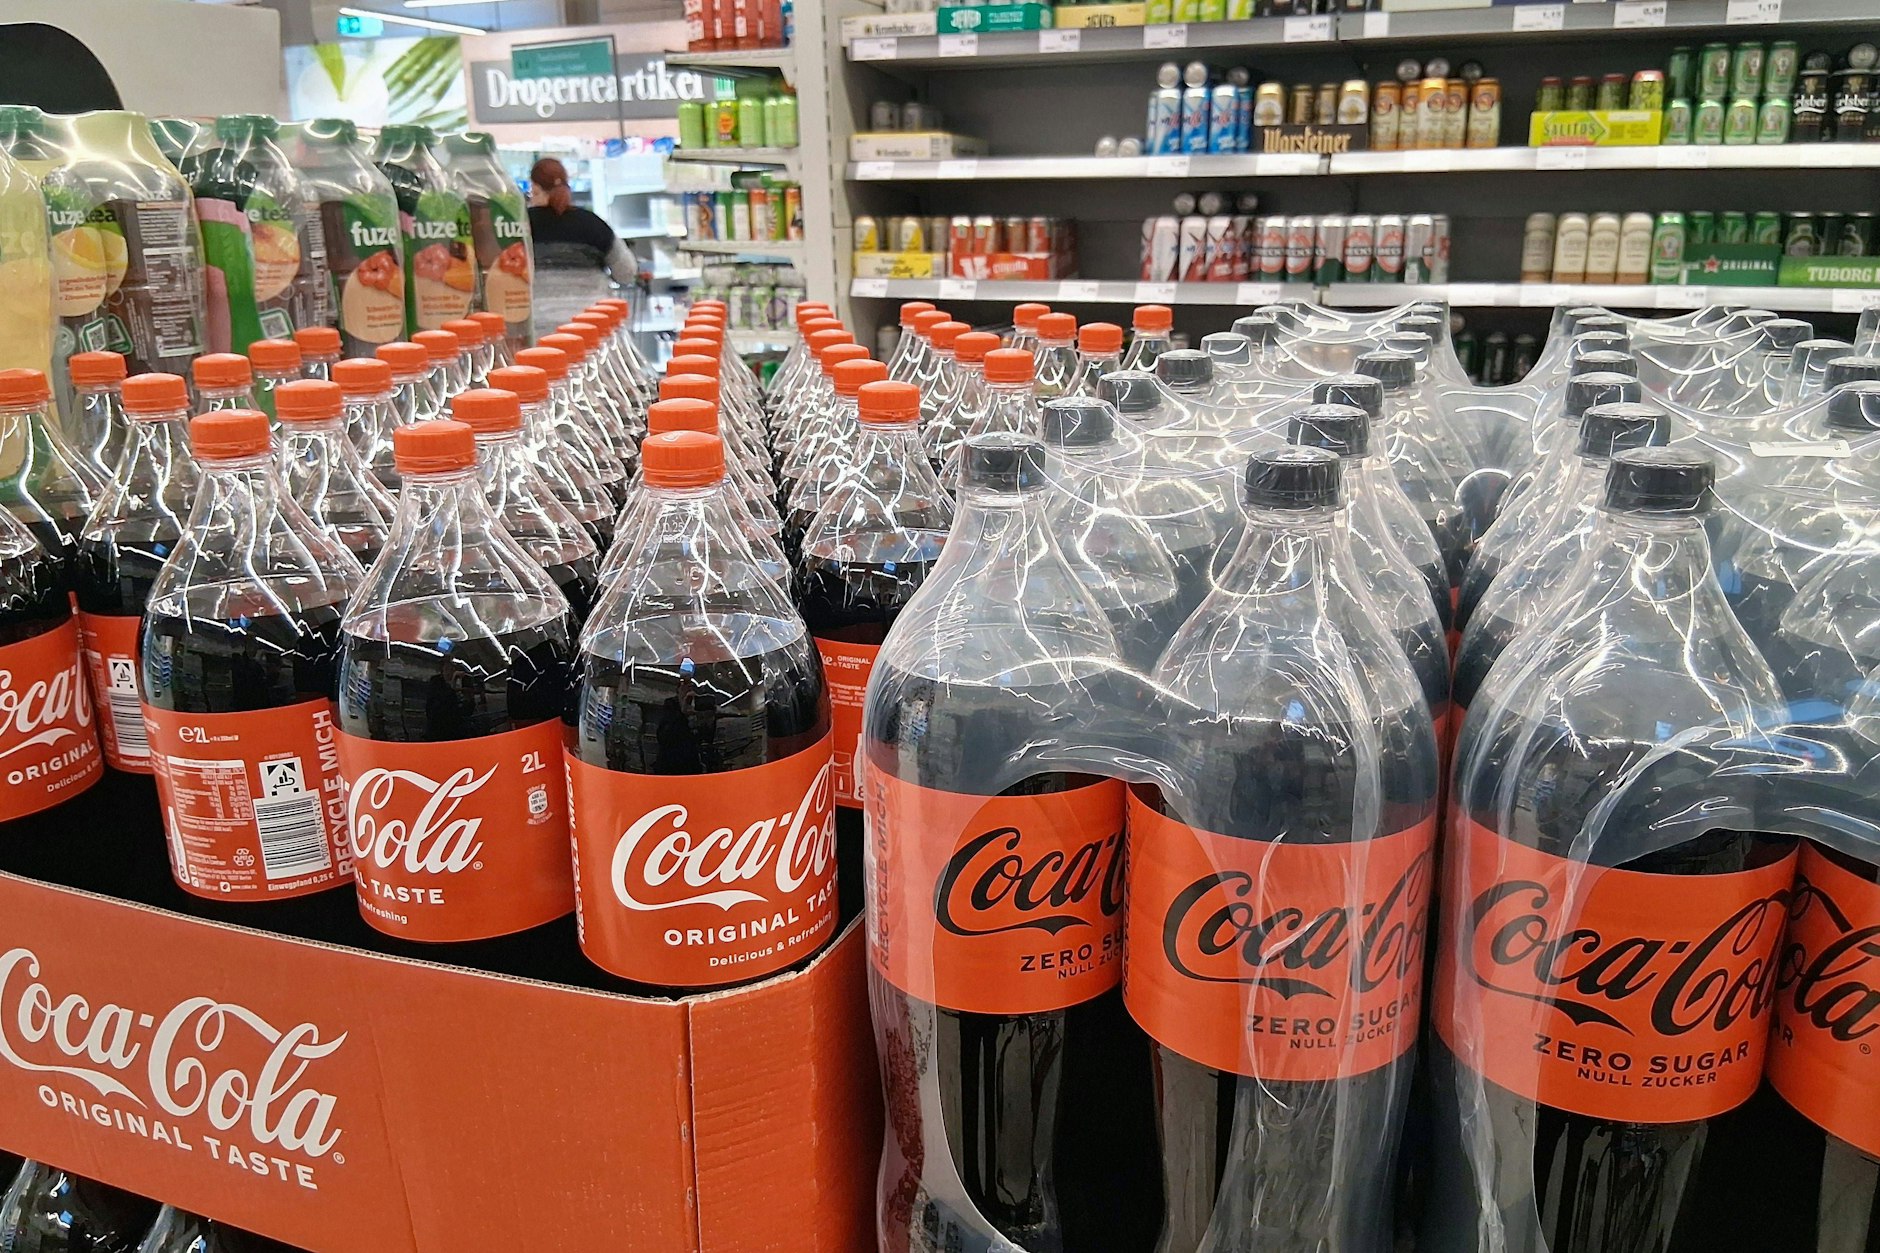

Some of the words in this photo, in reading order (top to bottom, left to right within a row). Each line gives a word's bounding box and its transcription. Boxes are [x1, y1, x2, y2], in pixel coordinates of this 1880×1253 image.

[1722, 261, 1775, 271] ORIGINAL
[1807, 266, 1872, 282] TUBORG
[837, 655, 871, 665] ORIGINAL
[838, 662, 860, 670] TASTE
[312, 709, 339, 772] MICH
[8, 739, 94, 785] ORIGINAL
[521, 751, 546, 773] 2L
[564, 761, 577, 829] MICH
[323, 774, 354, 877] RECYCLE
[268, 878, 312, 892] Einwegpfand
[370, 879, 445, 905] TASTE
[570, 833, 585, 944] RECYCLE
[664, 908, 800, 946] ORIGINAL
[709, 946, 773, 967] Delicious
[776, 941, 784, 951] &
[788, 909, 833, 946] Refreshing
[1020, 943, 1093, 972] ZERO
[1057, 961, 1096, 980] NULL
[1247, 1014, 1337, 1036] ZERO
[1289, 1036, 1337, 1049] NULL
[1345, 1021, 1394, 1045] ZUCKE
[0, 948, 348, 1158] Coca-Cola
[1532, 1032, 1632, 1071] ZERO
[1649, 1039, 1750, 1074] SUGAR
[1577, 1066, 1633, 1087] NULL
[1641, 1070, 1718, 1088] ZUCKER
[38, 1085, 193, 1152] ORIGINAL
[203, 1135, 319, 1191] TASTE
